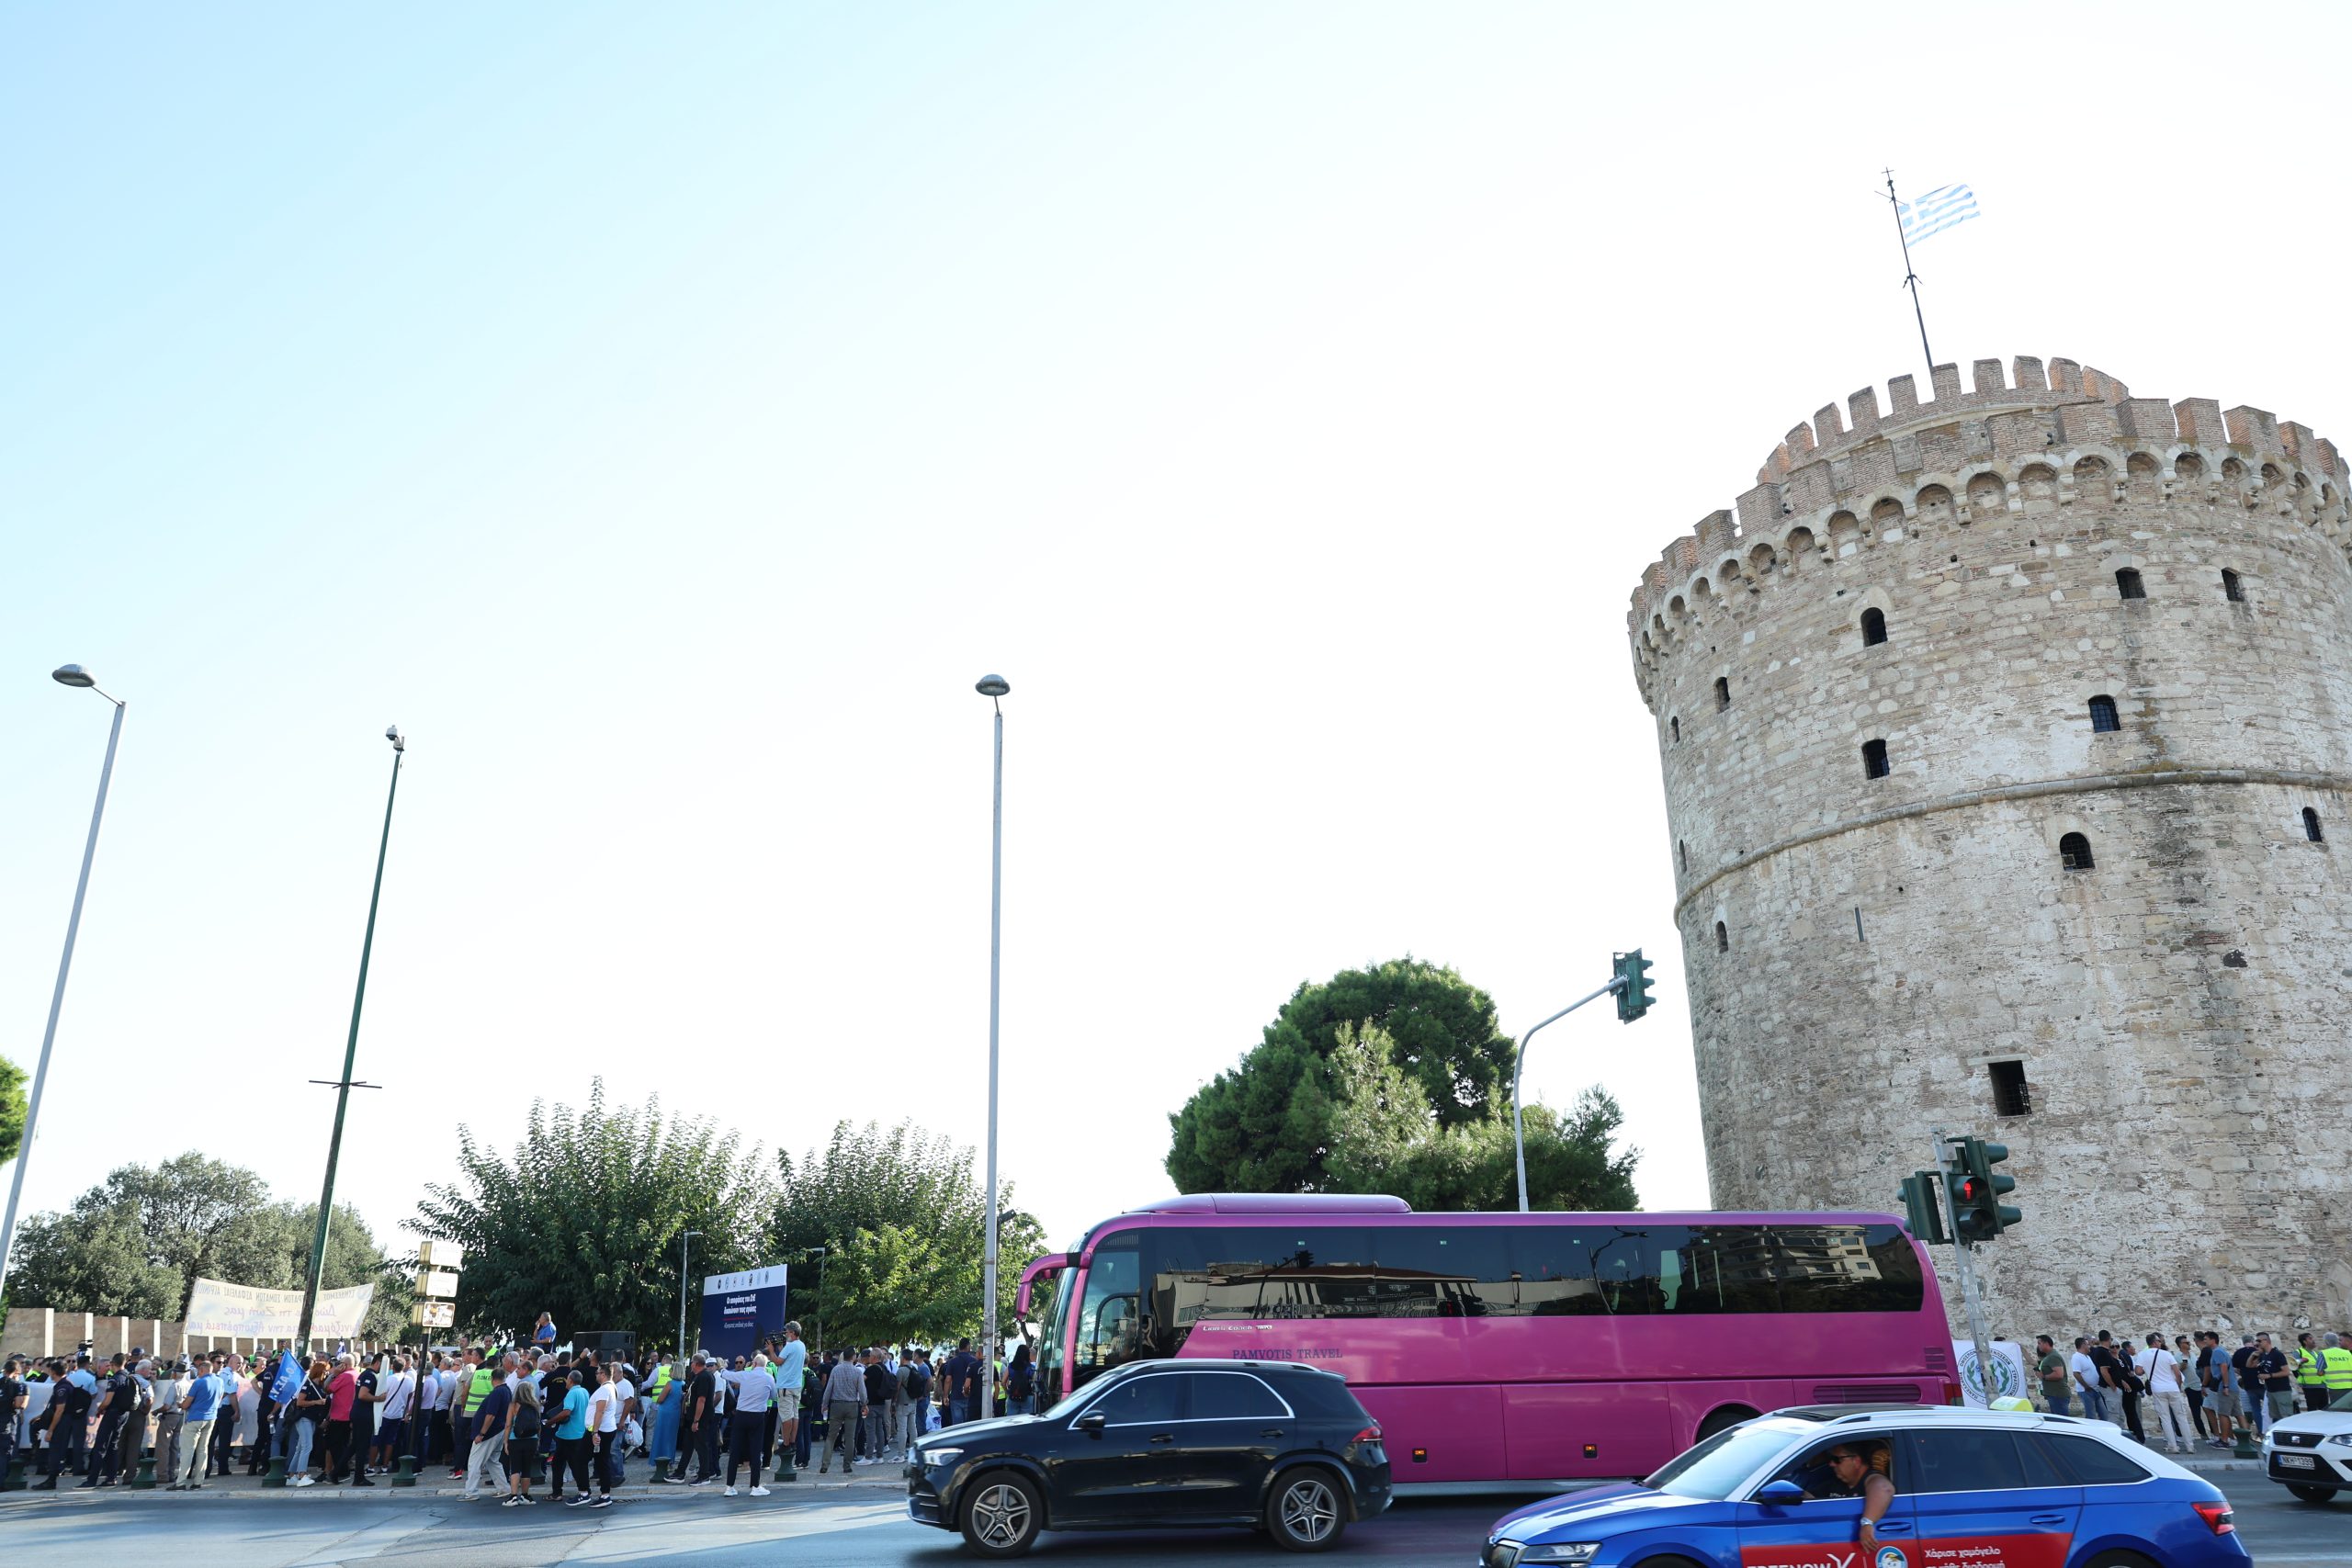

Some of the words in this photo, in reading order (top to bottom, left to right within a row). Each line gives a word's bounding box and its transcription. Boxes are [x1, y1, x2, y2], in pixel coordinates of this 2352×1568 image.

[1232, 1348, 1292, 1359] PAMVOTIS
[1297, 1348, 1343, 1359] TRAVEL
[1924, 1548, 1957, 1559] Χάρισε
[1958, 1546, 2001, 1559] χαμόγελο
